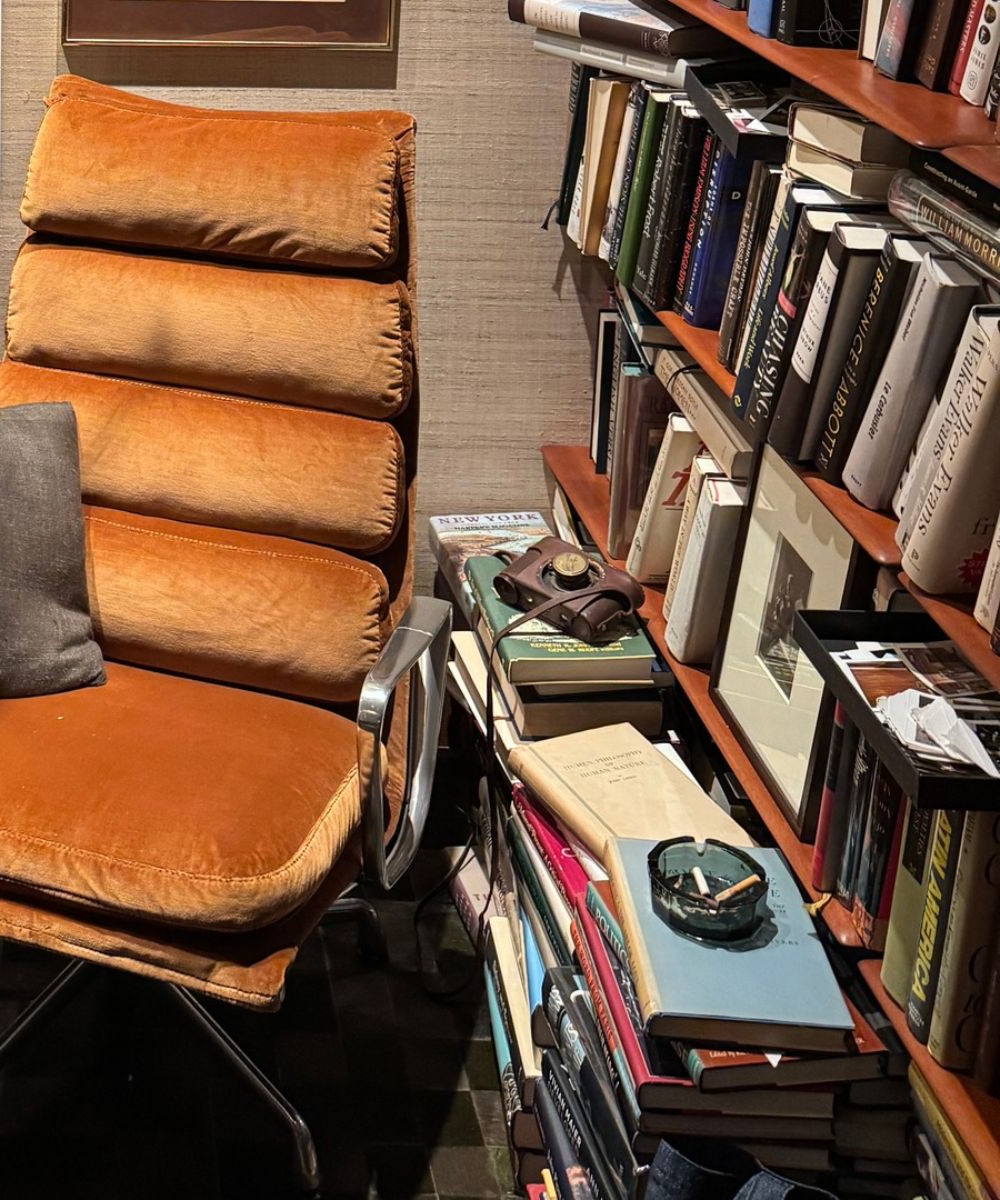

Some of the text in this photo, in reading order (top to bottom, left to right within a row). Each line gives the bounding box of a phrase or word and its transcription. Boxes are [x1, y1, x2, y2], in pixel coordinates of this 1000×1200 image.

[959, 8, 976, 52] MASTERS
[698, 133, 713, 178] WILLIAM
[641, 156, 665, 239] Robert Frost
[921, 205, 963, 239] WILLIAM
[674, 241, 694, 295] BIOGRAPHY
[725, 285, 738, 318] CRAFT
[743, 245, 780, 369] Josef Albers Life and Work
[755, 313, 789, 418] CHASING
[820, 267, 885, 458] BERENICE ABBOTT
[867, 381, 892, 440] Le Corbusier
[933, 334, 984, 462] Walker Evans
[917, 371, 988, 537] Walker Evans
[484, 513, 538, 521] YORK
[580, 769, 611, 778] HUMAN
[911, 874, 940, 1003] AMERICA
[548, 1071, 582, 1148] VIVIAN MAIER
